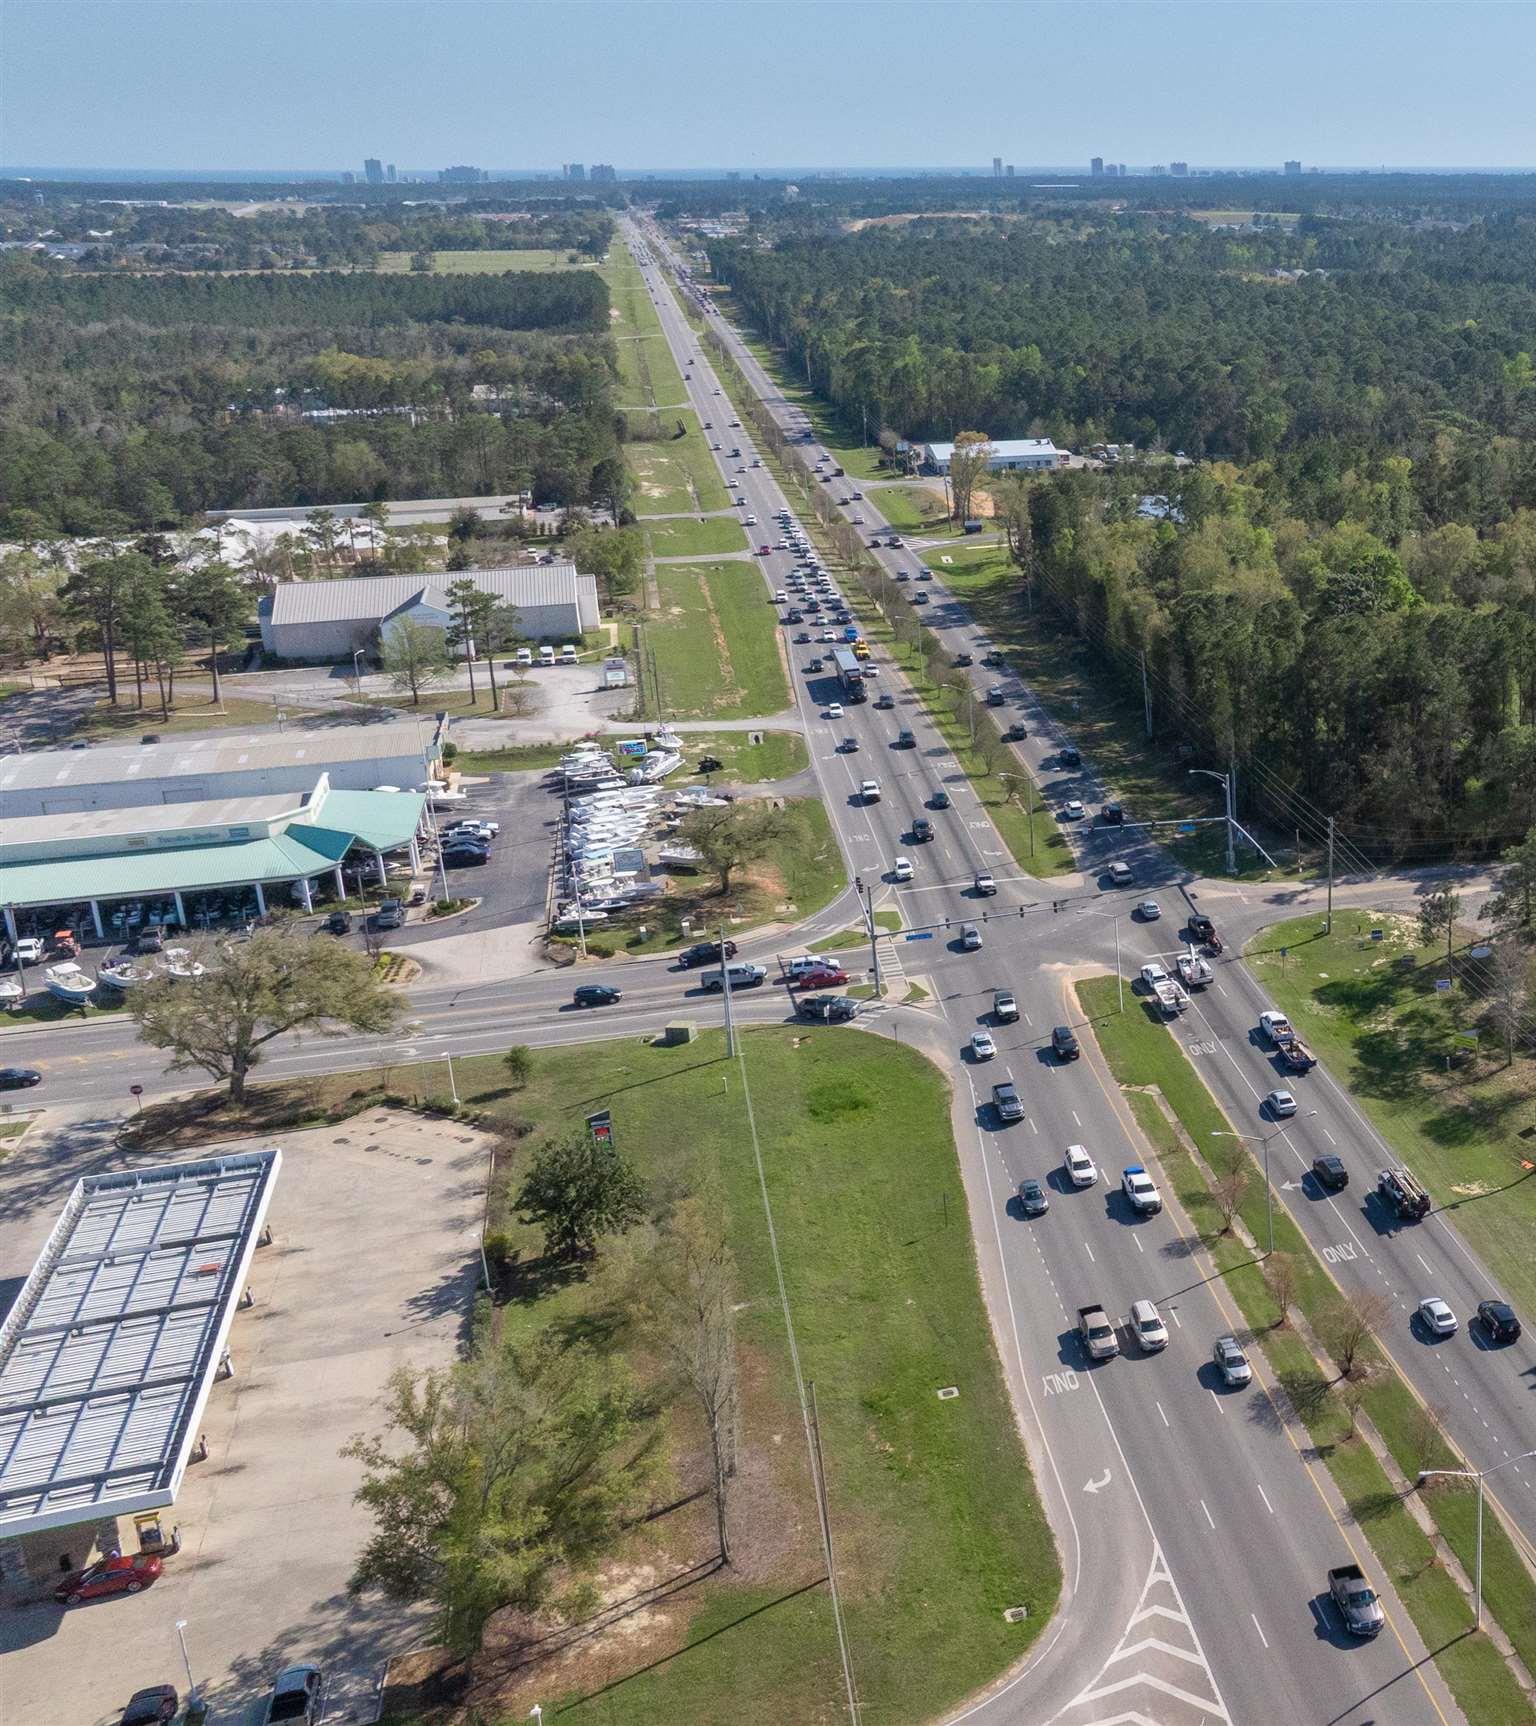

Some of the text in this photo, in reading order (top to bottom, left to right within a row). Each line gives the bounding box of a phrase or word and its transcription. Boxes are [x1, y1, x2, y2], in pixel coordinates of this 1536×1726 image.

[1189, 1041, 1217, 1056] ONLY
[1322, 1242, 1358, 1263] ONLY
[1042, 1370, 1080, 1397] ONLY
